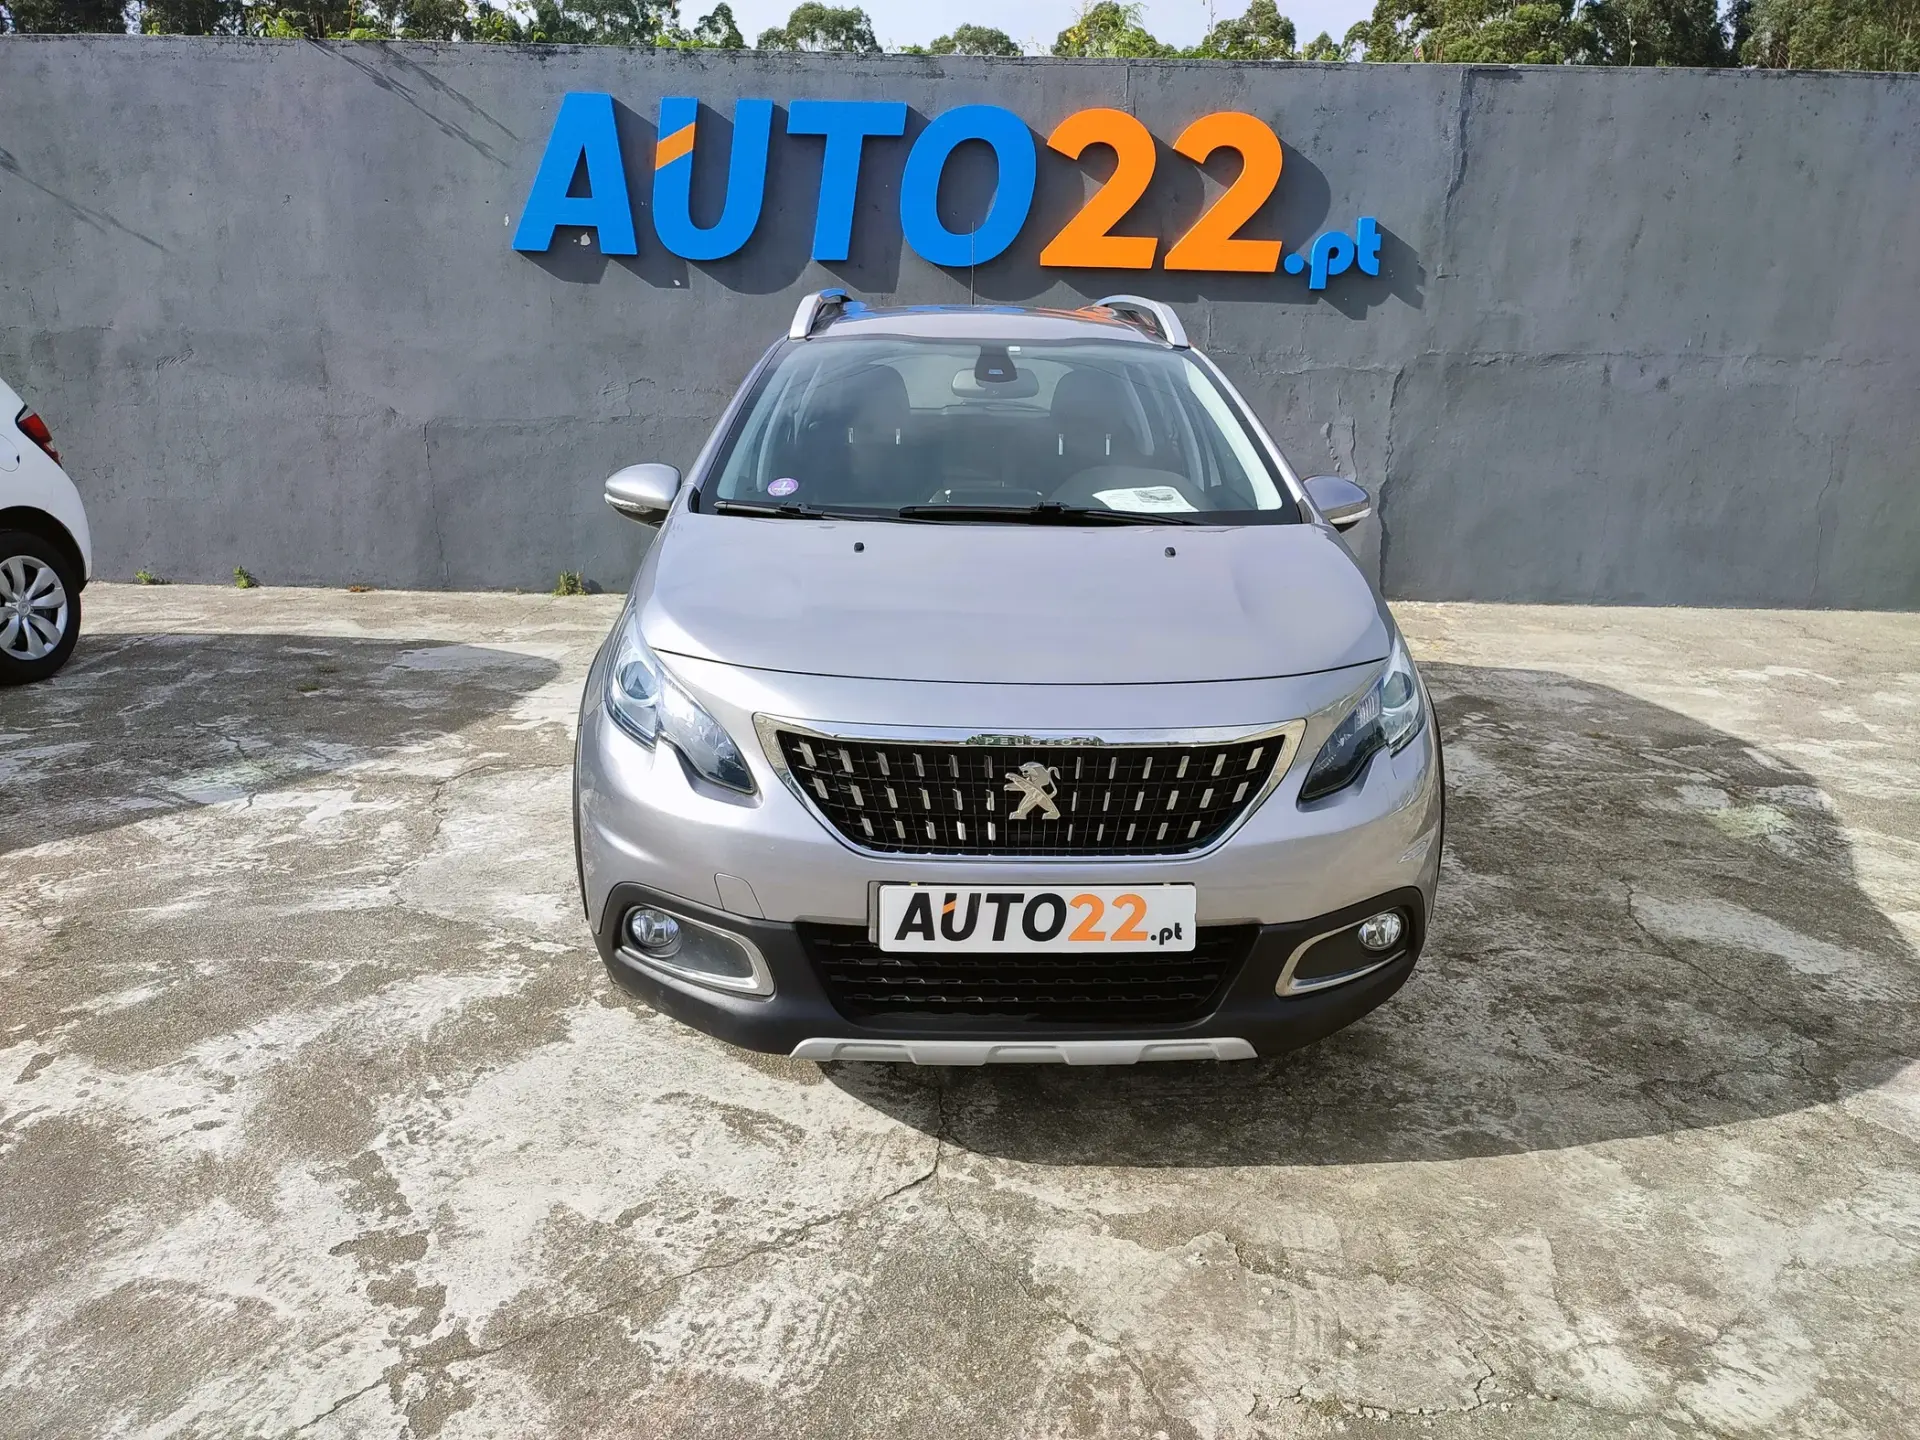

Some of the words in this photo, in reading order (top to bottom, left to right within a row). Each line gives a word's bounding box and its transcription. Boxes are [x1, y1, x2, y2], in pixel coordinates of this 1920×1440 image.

[512, 93, 1382, 290] AUTO22.pt
[984, 736, 1088, 747] PEUGEOT
[894, 892, 1184, 946] AUTO22.pt
